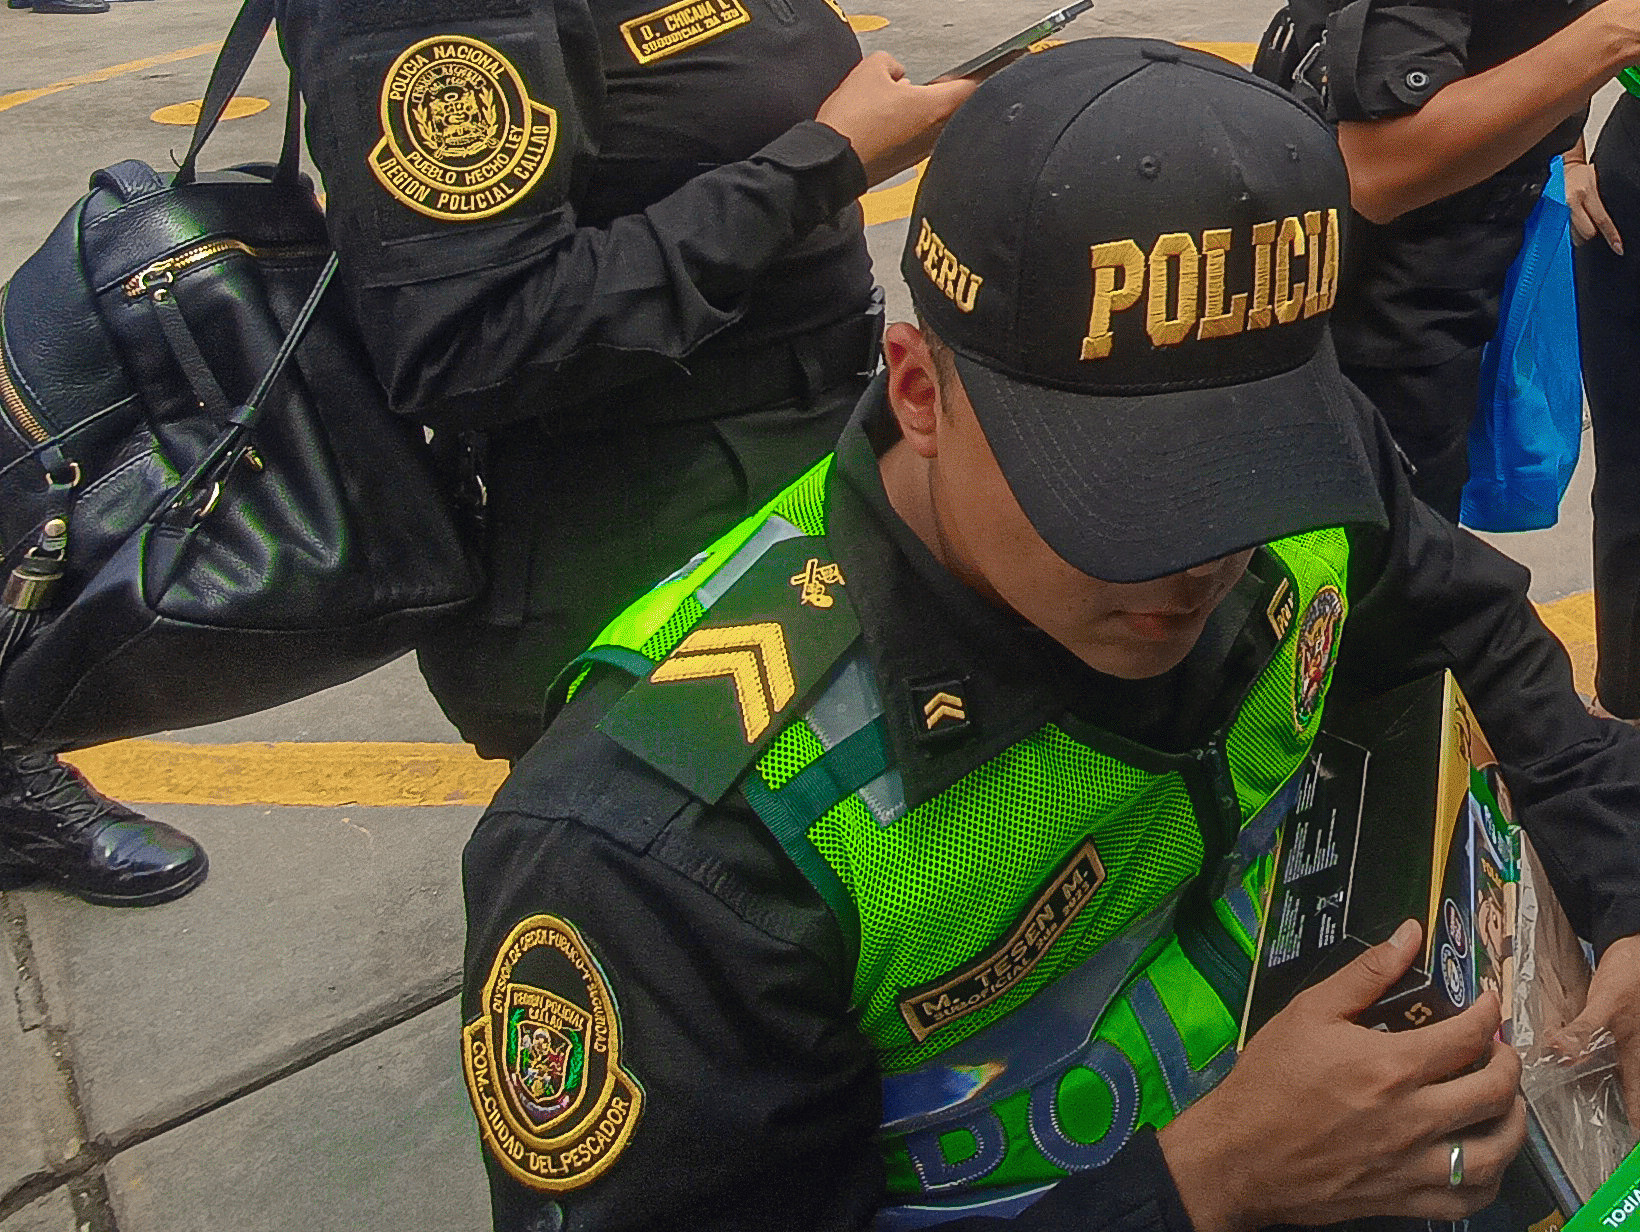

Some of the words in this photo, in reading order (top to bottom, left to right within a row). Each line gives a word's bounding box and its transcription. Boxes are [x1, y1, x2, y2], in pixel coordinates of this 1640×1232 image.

[389, 54, 430, 101] POLICIA
[432, 44, 505, 80] NACIONAL
[379, 157, 431, 203] REGION
[436, 181, 515, 211] POLICIAL
[513, 124, 550, 180] CALLAO
[406, 151, 457, 185] PUEBLO
[464, 152, 510, 186] HECHO
[505, 124, 525, 150] LEY
[921, 993, 961, 1016] M.
[974, 903, 1055, 988] TESEN
[1062, 868, 1090, 900] M.
[484, 1094, 525, 1161] CIUDAD
[527, 1151, 557, 1173] DEL
[559, 1096, 630, 1173] PESCADOR
